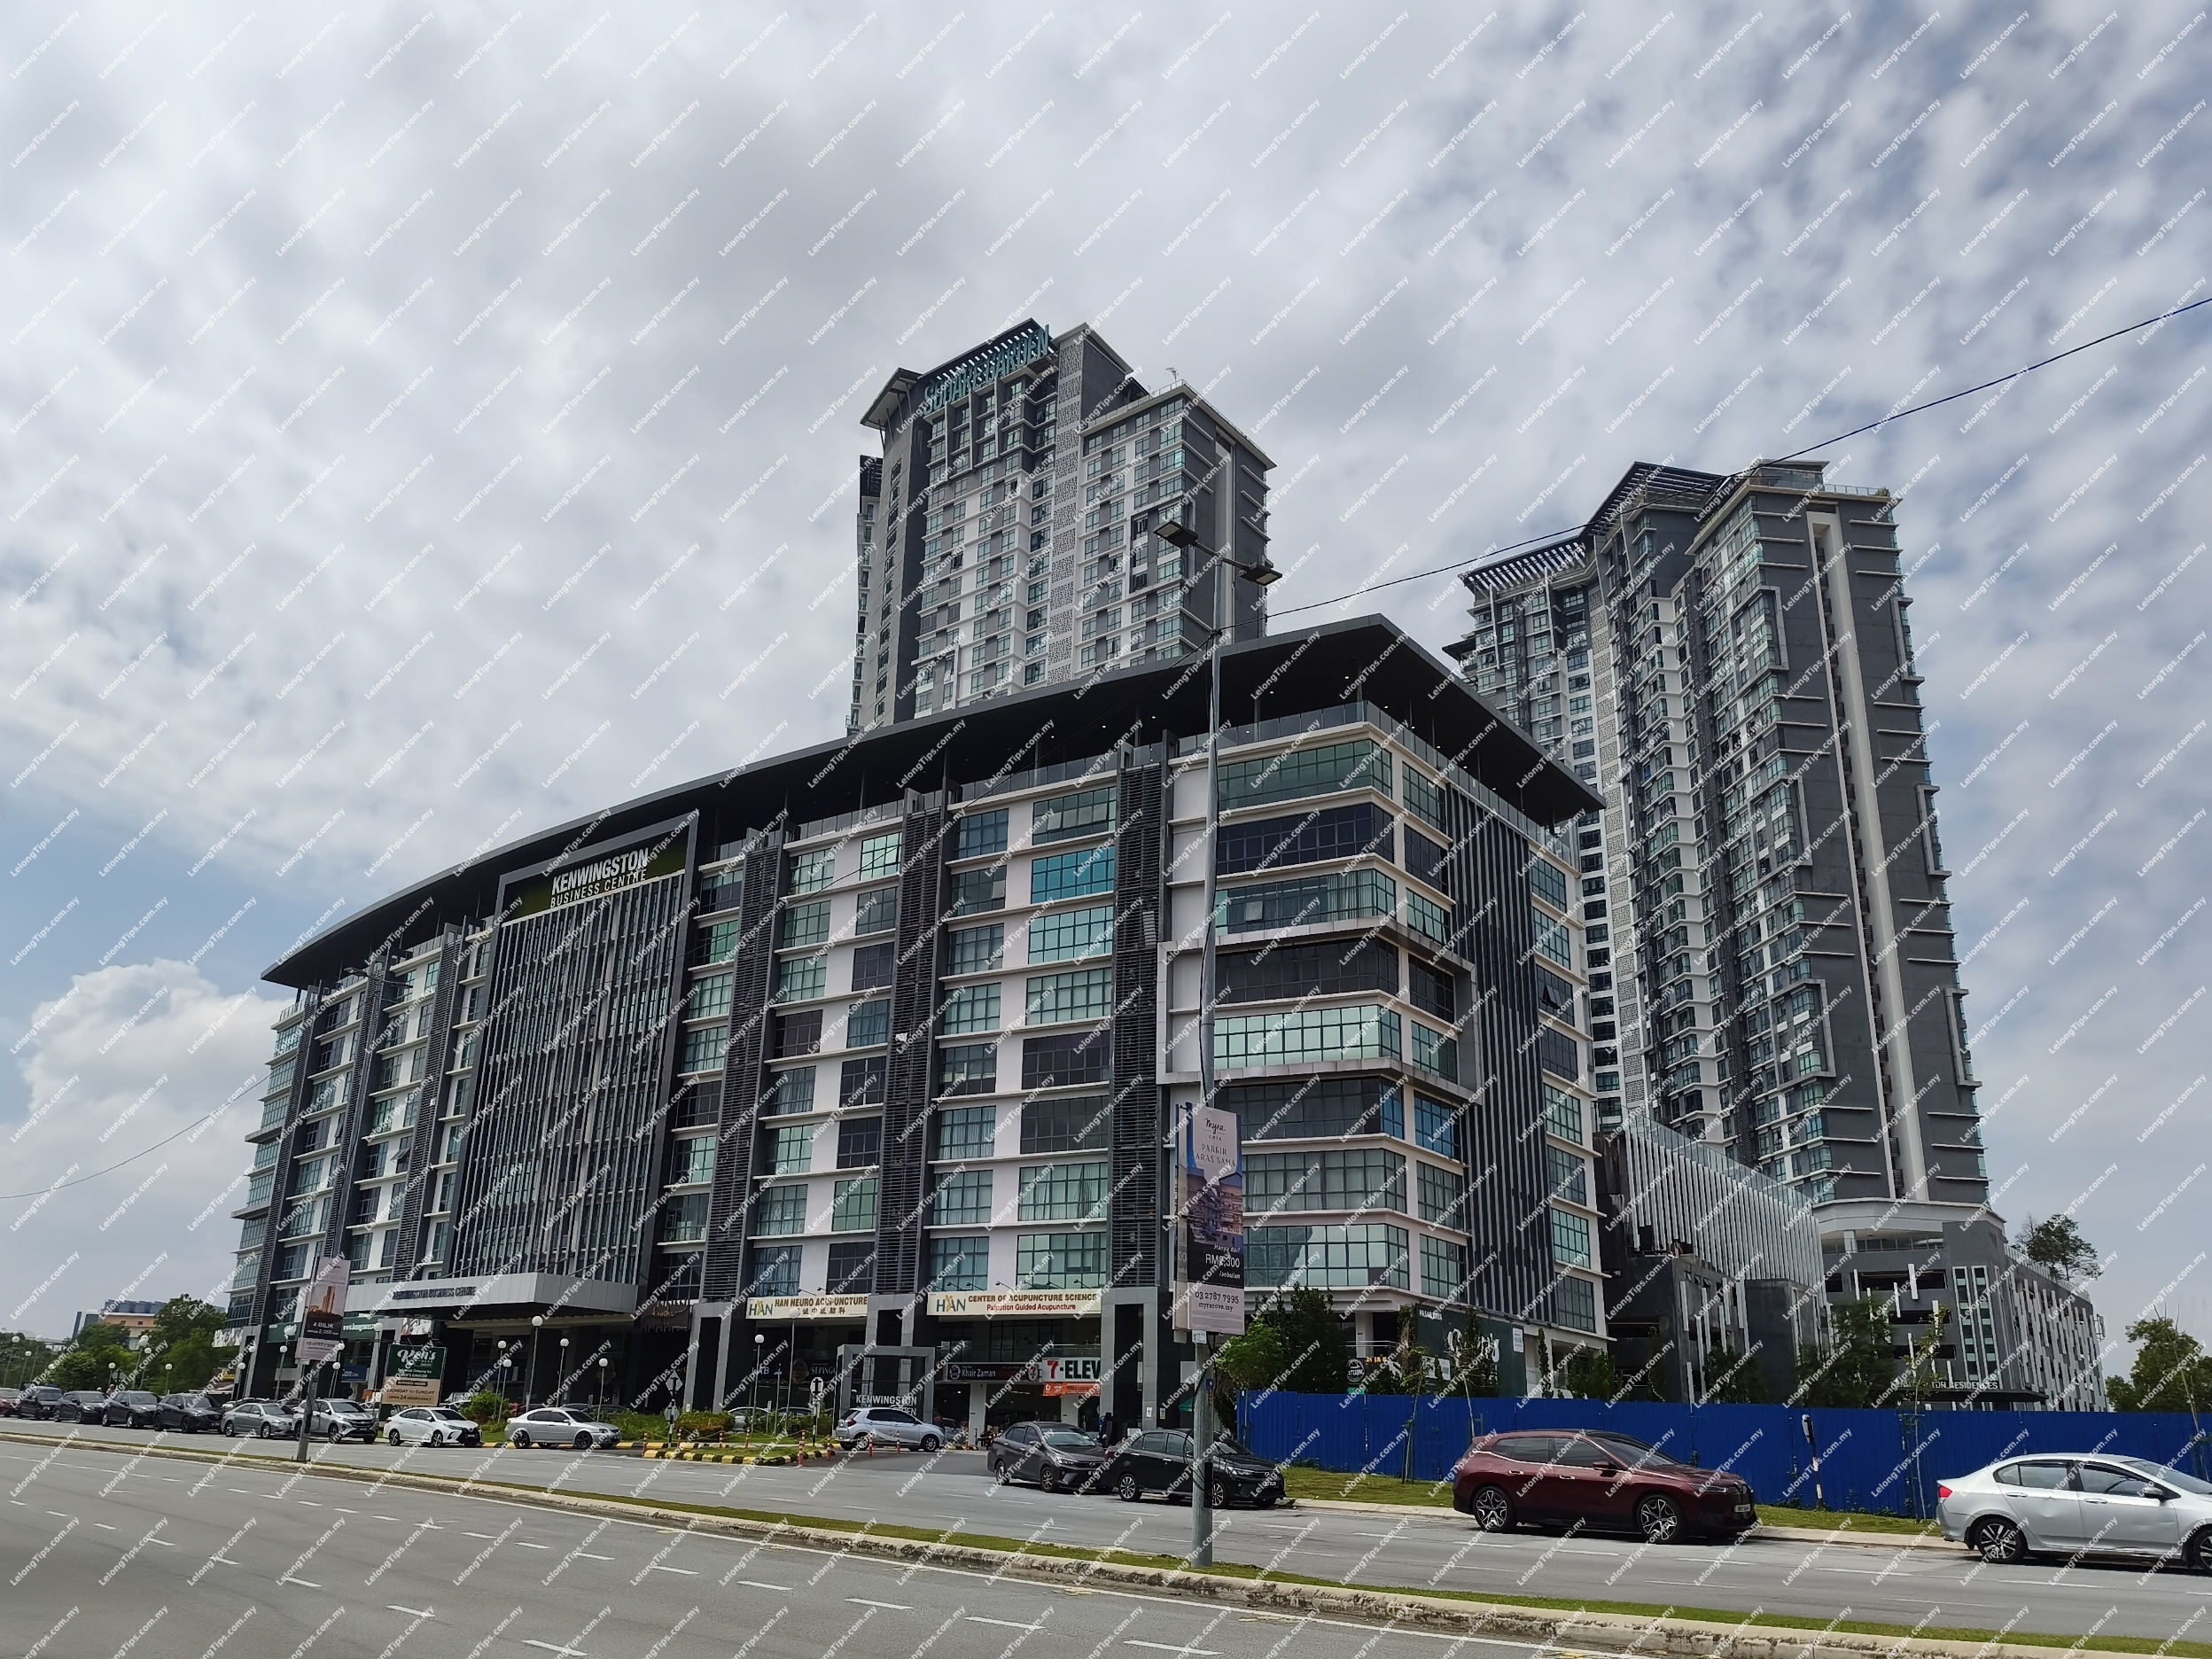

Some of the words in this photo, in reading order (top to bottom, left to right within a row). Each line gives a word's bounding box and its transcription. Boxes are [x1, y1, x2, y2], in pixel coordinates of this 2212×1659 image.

[985, 324, 1049, 385] GARDEN
[551, 847, 649, 895] KENWINGSTON
[550, 882, 601, 908] BUSINESS
[604, 868, 648, 892] CENTRE
[1202, 1143, 1227, 1156] PARKIR
[1196, 1153, 1215, 1164] ARAS
[1216, 1157, 1236, 1168] SAMA
[775, 1298, 789, 1307] HAN
[791, 1297, 814, 1307] NEURO
[1195, 1291, 1203, 1300] 03
[1204, 1291, 1221, 1301] 2787
[1222, 1294, 1240, 1305] 7995
[1015, 1303, 1037, 1312] Guided
[1038, 1303, 1076, 1312] Acupuncture
[962, 1367, 977, 1377] Khair
[977, 1367, 996, 1377] Zaman
[856, 1394, 917, 1406] KENWINGSTON
